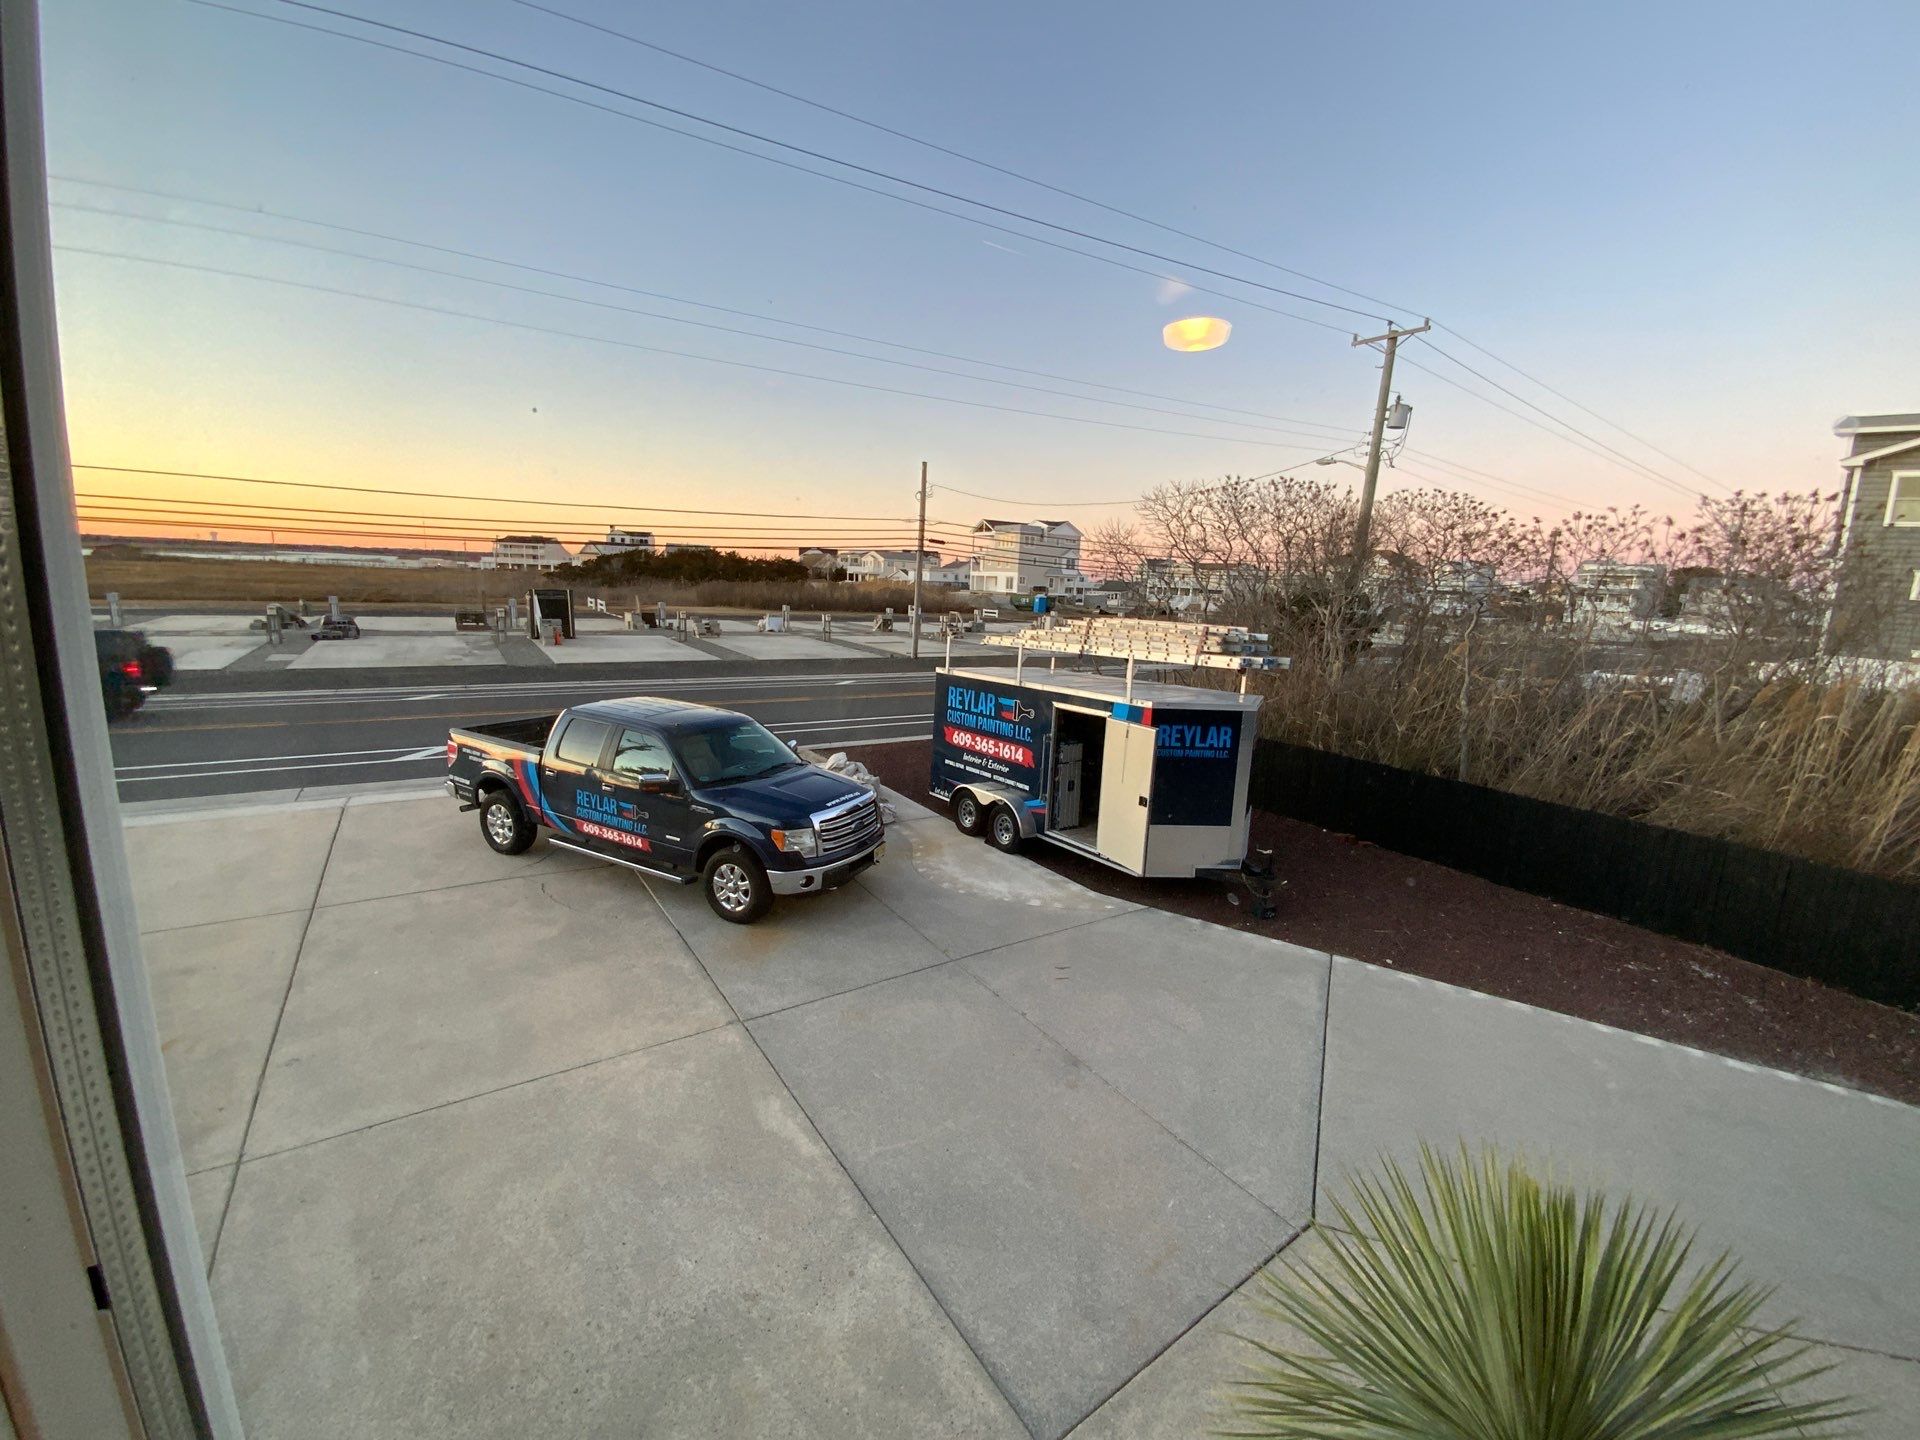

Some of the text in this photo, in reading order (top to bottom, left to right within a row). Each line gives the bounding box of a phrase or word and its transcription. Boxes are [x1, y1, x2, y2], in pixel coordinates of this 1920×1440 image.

[947, 686, 996, 717] REYLAR
[947, 709, 1033, 742] CUSTOM PAINTING LLC.
[1157, 724, 1232, 748] REYLAR
[952, 730, 1024, 763] 609-365-1614
[1156, 748, 1184, 757] CUSTOM
[1184, 749, 1215, 758] PAINTING
[962, 752, 982, 765] Interior
[981, 757, 987, 767] &
[987, 759, 1009, 773] Exterior
[576, 789, 617, 815] REYLAR
[576, 806, 648, 835] CUSTOM PAINTING LLC.
[582, 822, 643, 848] 609-365-1614
